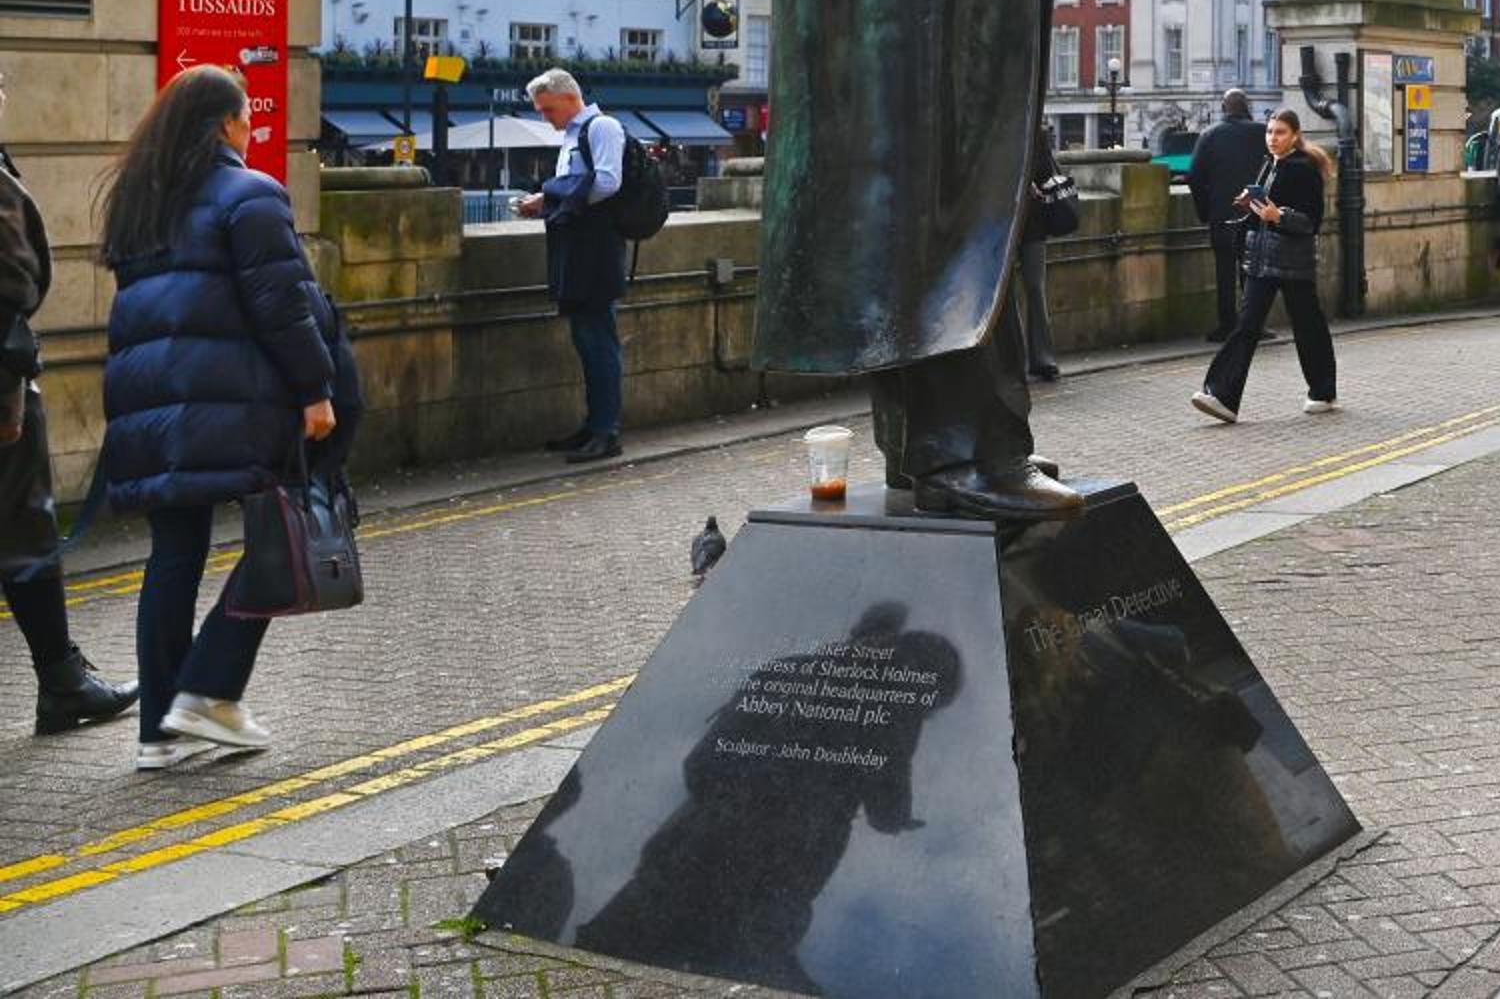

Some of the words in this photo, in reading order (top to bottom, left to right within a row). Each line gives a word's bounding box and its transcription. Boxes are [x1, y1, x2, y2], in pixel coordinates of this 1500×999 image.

[851, 644, 896, 661] Street
[800, 659, 818, 676] of
[817, 660, 880, 681] Sherlock
[881, 665, 939, 686] Holmes
[763, 677, 819, 698] original
[820, 680, 917, 706] headquarters
[920, 690, 939, 707] of
[735, 695, 790, 718] Abbey
[791, 700, 860, 724] National
[862, 704, 892, 726] plc
[714, 736, 771, 758] Sculptor
[777, 741, 811, 760] John
[813, 745, 888, 769] Doubleday
